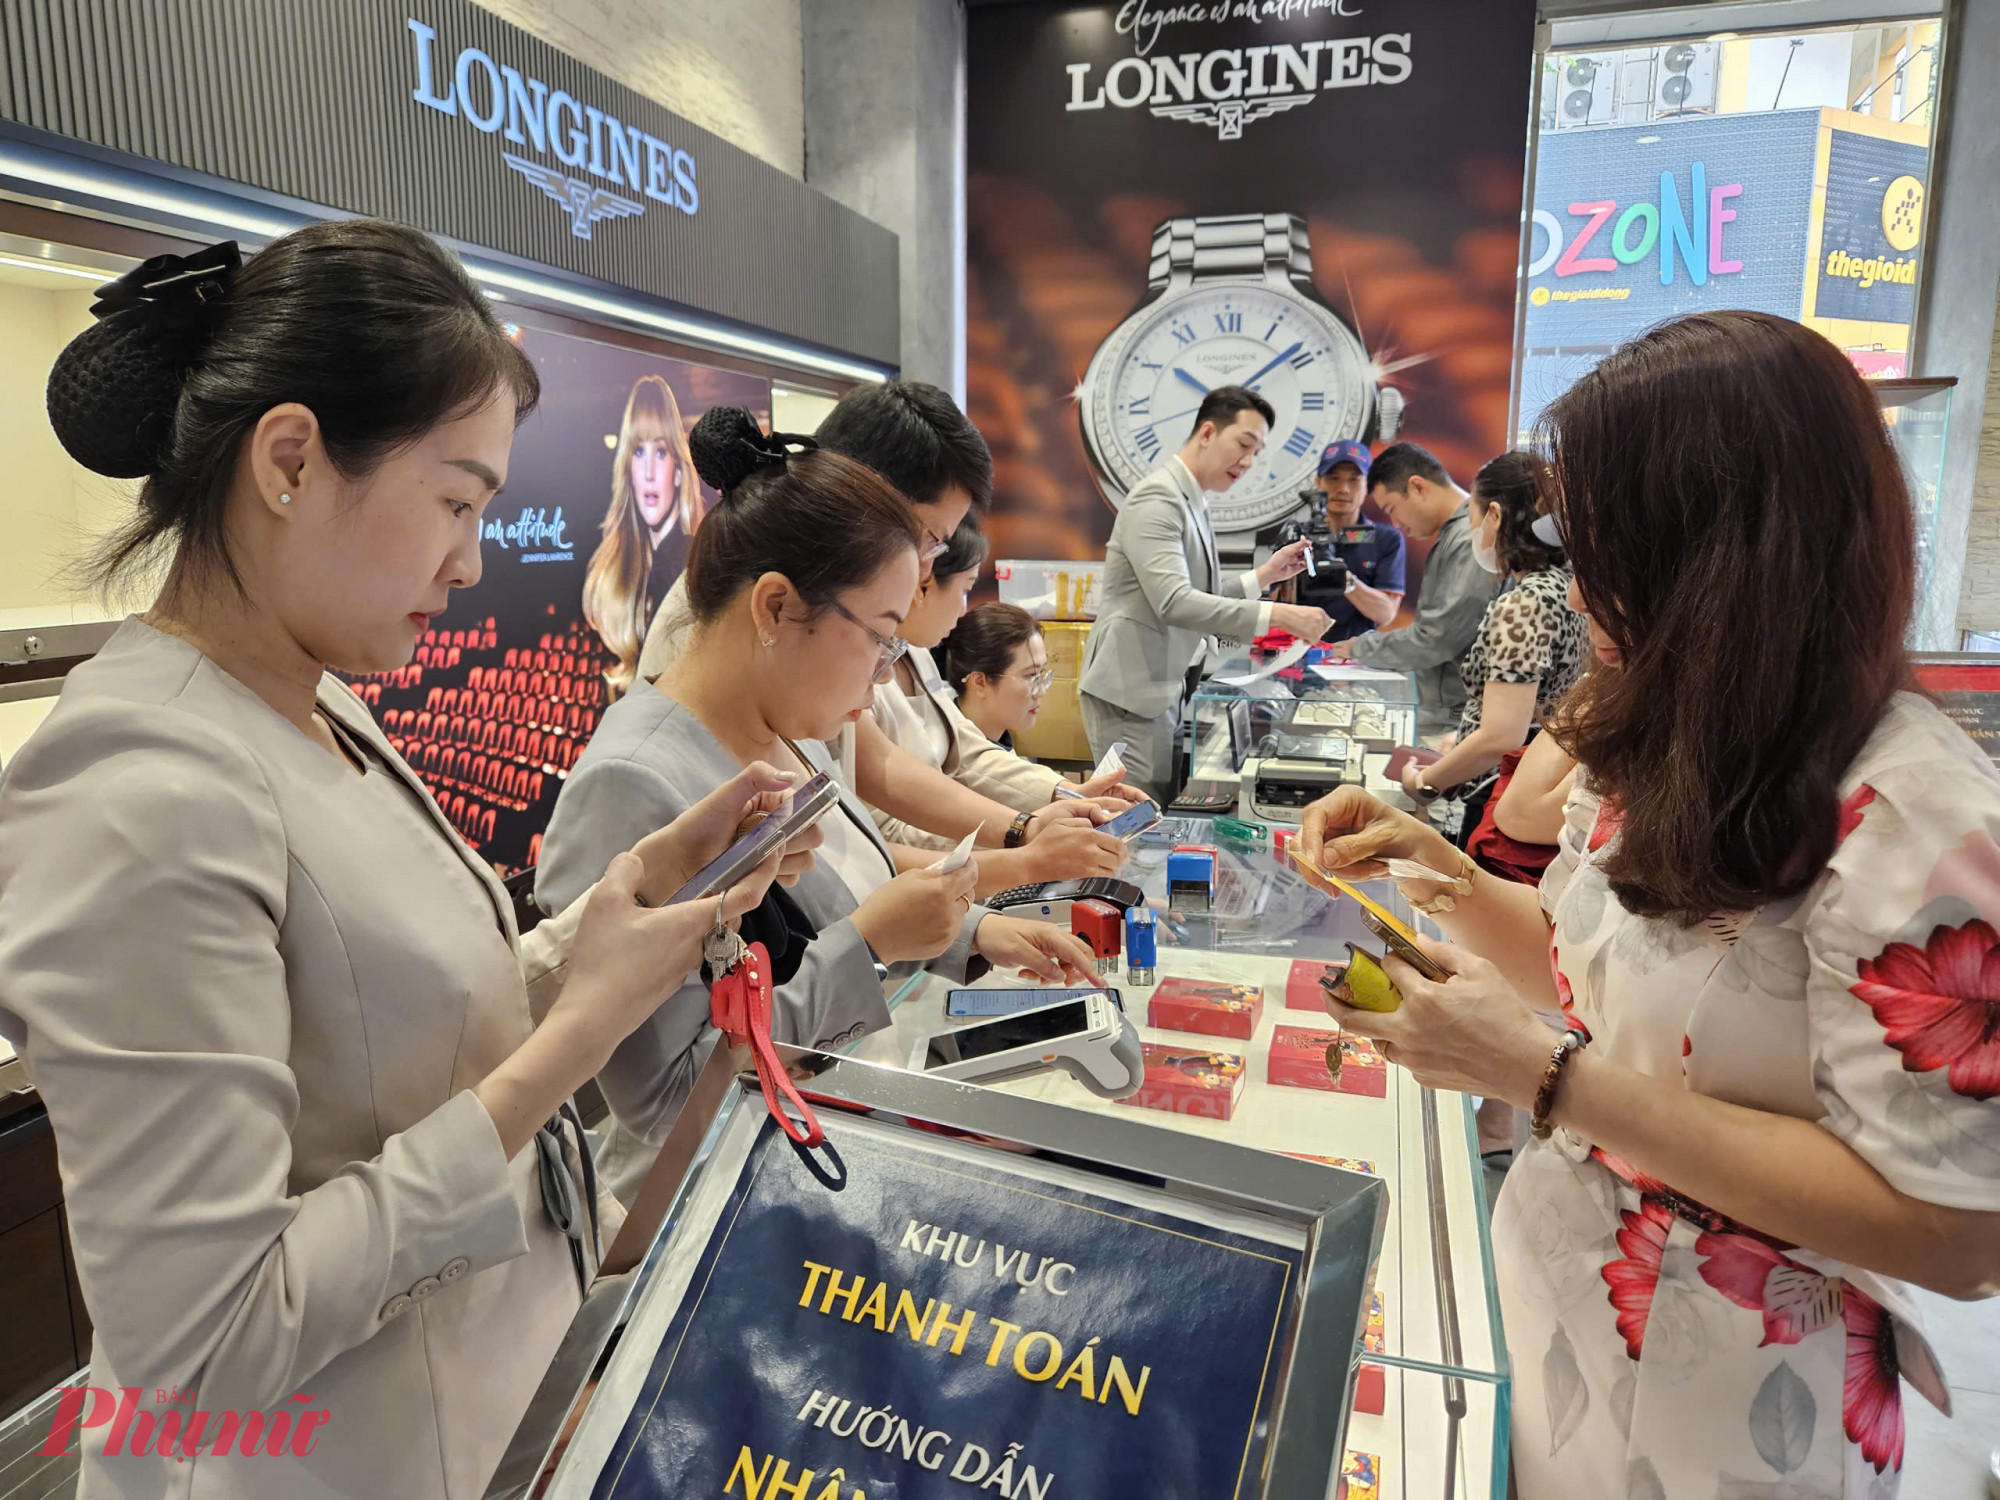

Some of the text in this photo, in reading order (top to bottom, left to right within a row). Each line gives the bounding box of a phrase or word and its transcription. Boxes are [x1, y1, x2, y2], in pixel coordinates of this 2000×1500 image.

[408, 17, 699, 215] LONGINES
[1065, 33, 1413, 111] LONGINES
[899, 1219, 1077, 1297] KHU VỰC
[798, 1260, 1151, 1416] THANH TOÁN
[722, 1445, 886, 1500] NHÂ
[796, 1390, 1055, 1500] HƯỚNG DẪN
